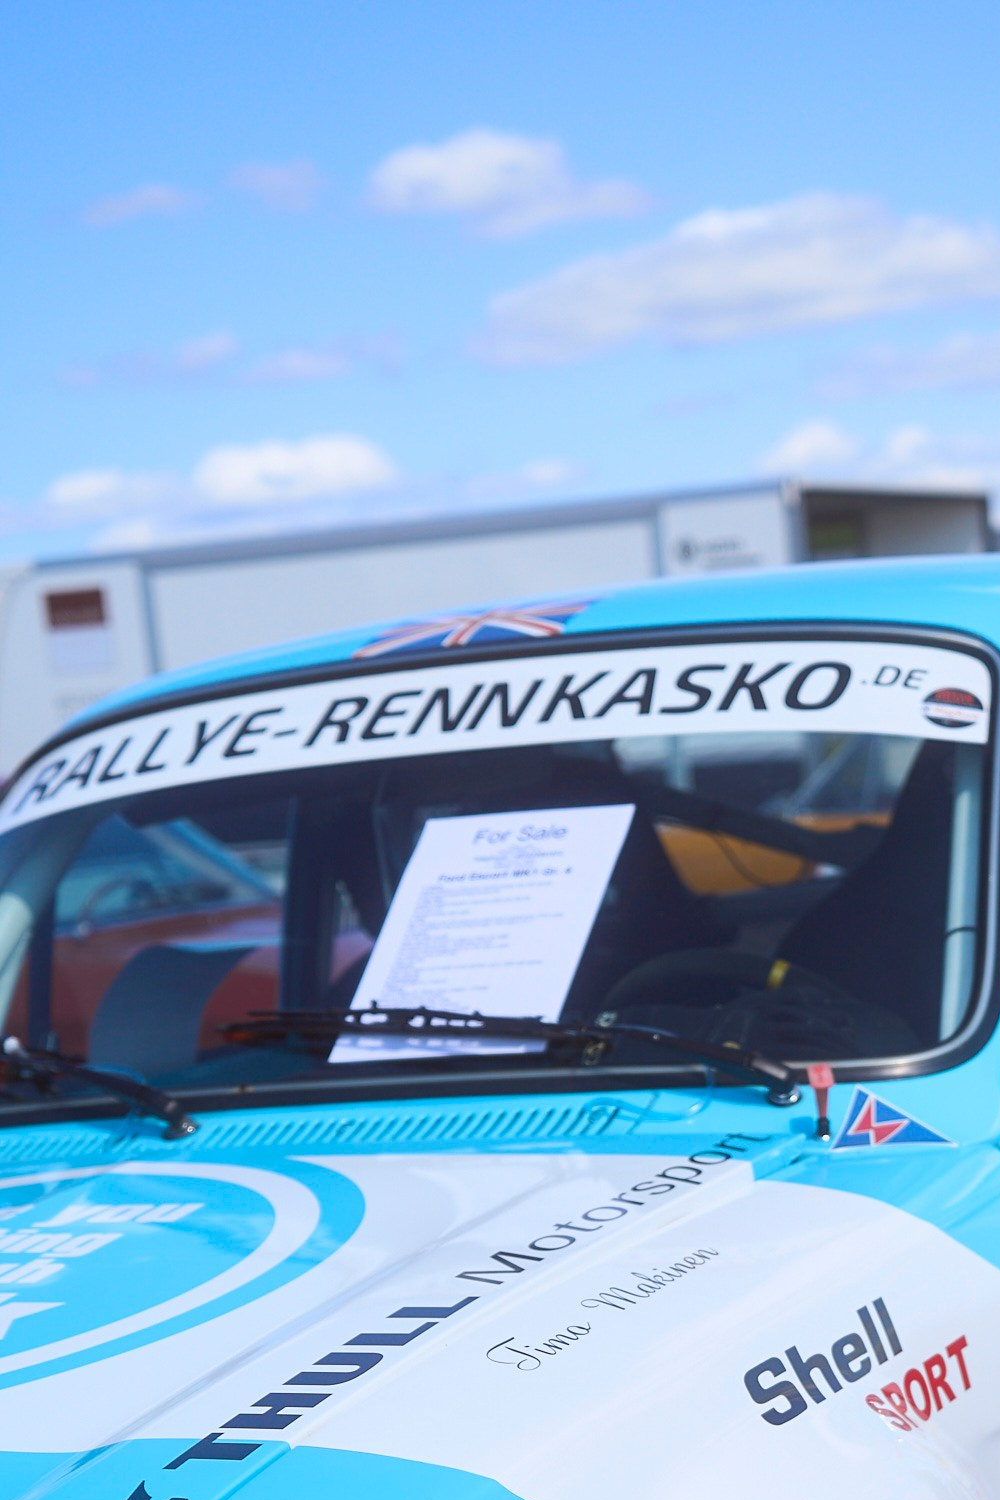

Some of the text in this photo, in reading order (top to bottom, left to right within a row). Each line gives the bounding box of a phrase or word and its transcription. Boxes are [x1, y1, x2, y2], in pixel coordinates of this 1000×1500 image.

[472, 824, 569, 845] For Sale
[30, 1202, 206, 1228] you
[162, 1131, 772, 1470] THULL Motorsport
[486, 1246, 719, 1372] Timo Makinen
[743, 1296, 903, 1426] Shell
[865, 1335, 974, 1433] SPORT
